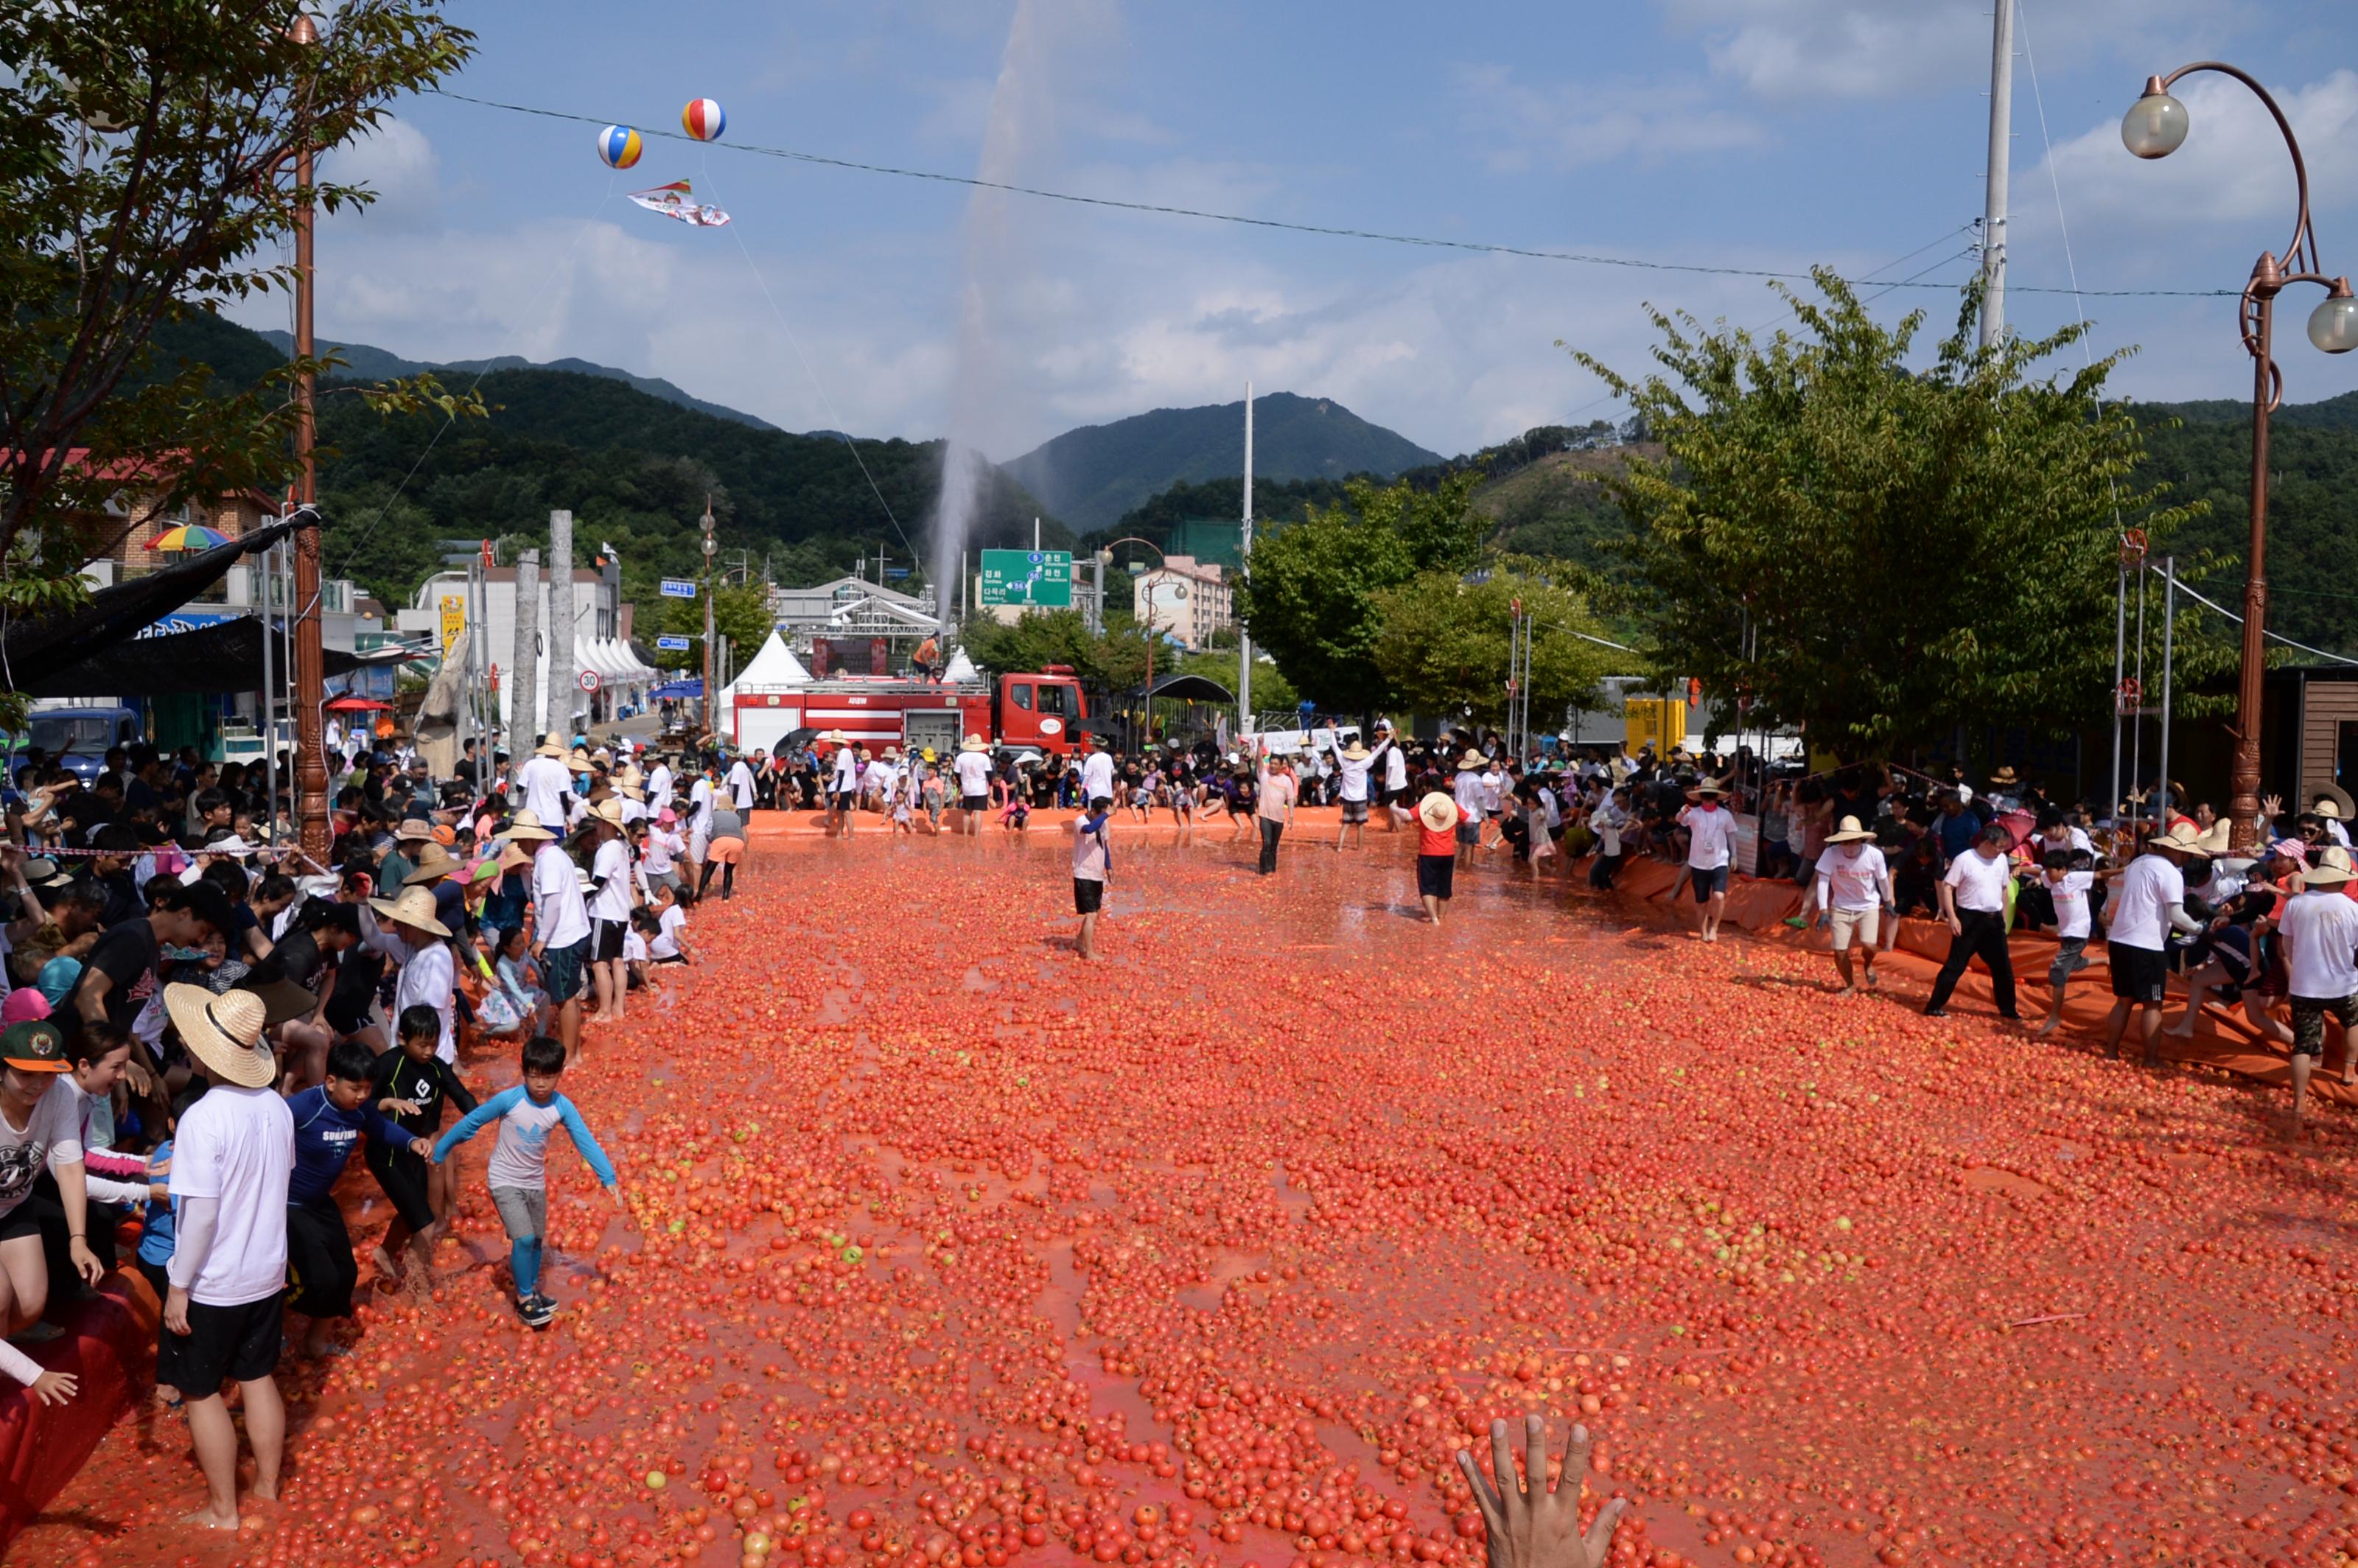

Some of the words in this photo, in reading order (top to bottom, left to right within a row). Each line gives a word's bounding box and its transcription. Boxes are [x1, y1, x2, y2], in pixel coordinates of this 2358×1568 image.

[1045, 553, 1061, 562] 춘천
[1045, 569, 1061, 577] 화천
[584, 676, 595, 686] 30
[322, 1129, 357, 1141] SURFING
